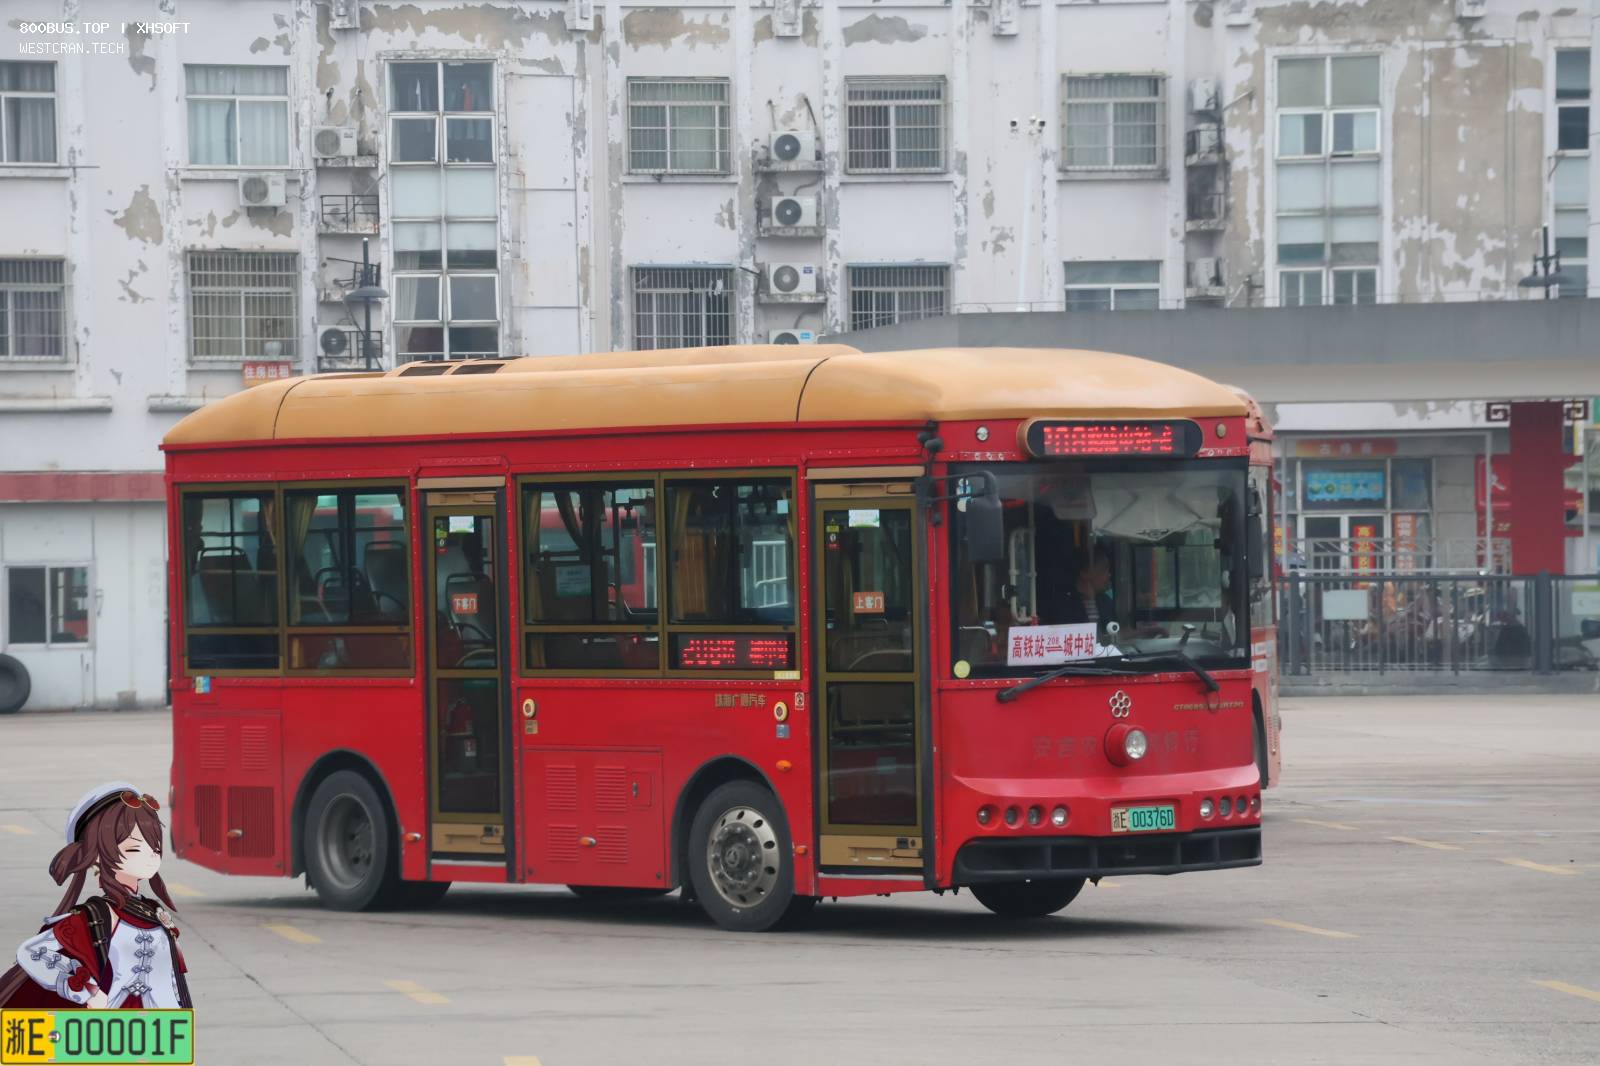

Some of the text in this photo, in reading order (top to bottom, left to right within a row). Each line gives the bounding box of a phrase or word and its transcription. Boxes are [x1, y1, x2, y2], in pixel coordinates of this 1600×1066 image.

[454, 597, 477, 610] 下客门
[855, 596, 883, 609] 上客门
[1012, 633, 1045, 658] 高铁站
[1063, 632, 1095, 657] 城中站
